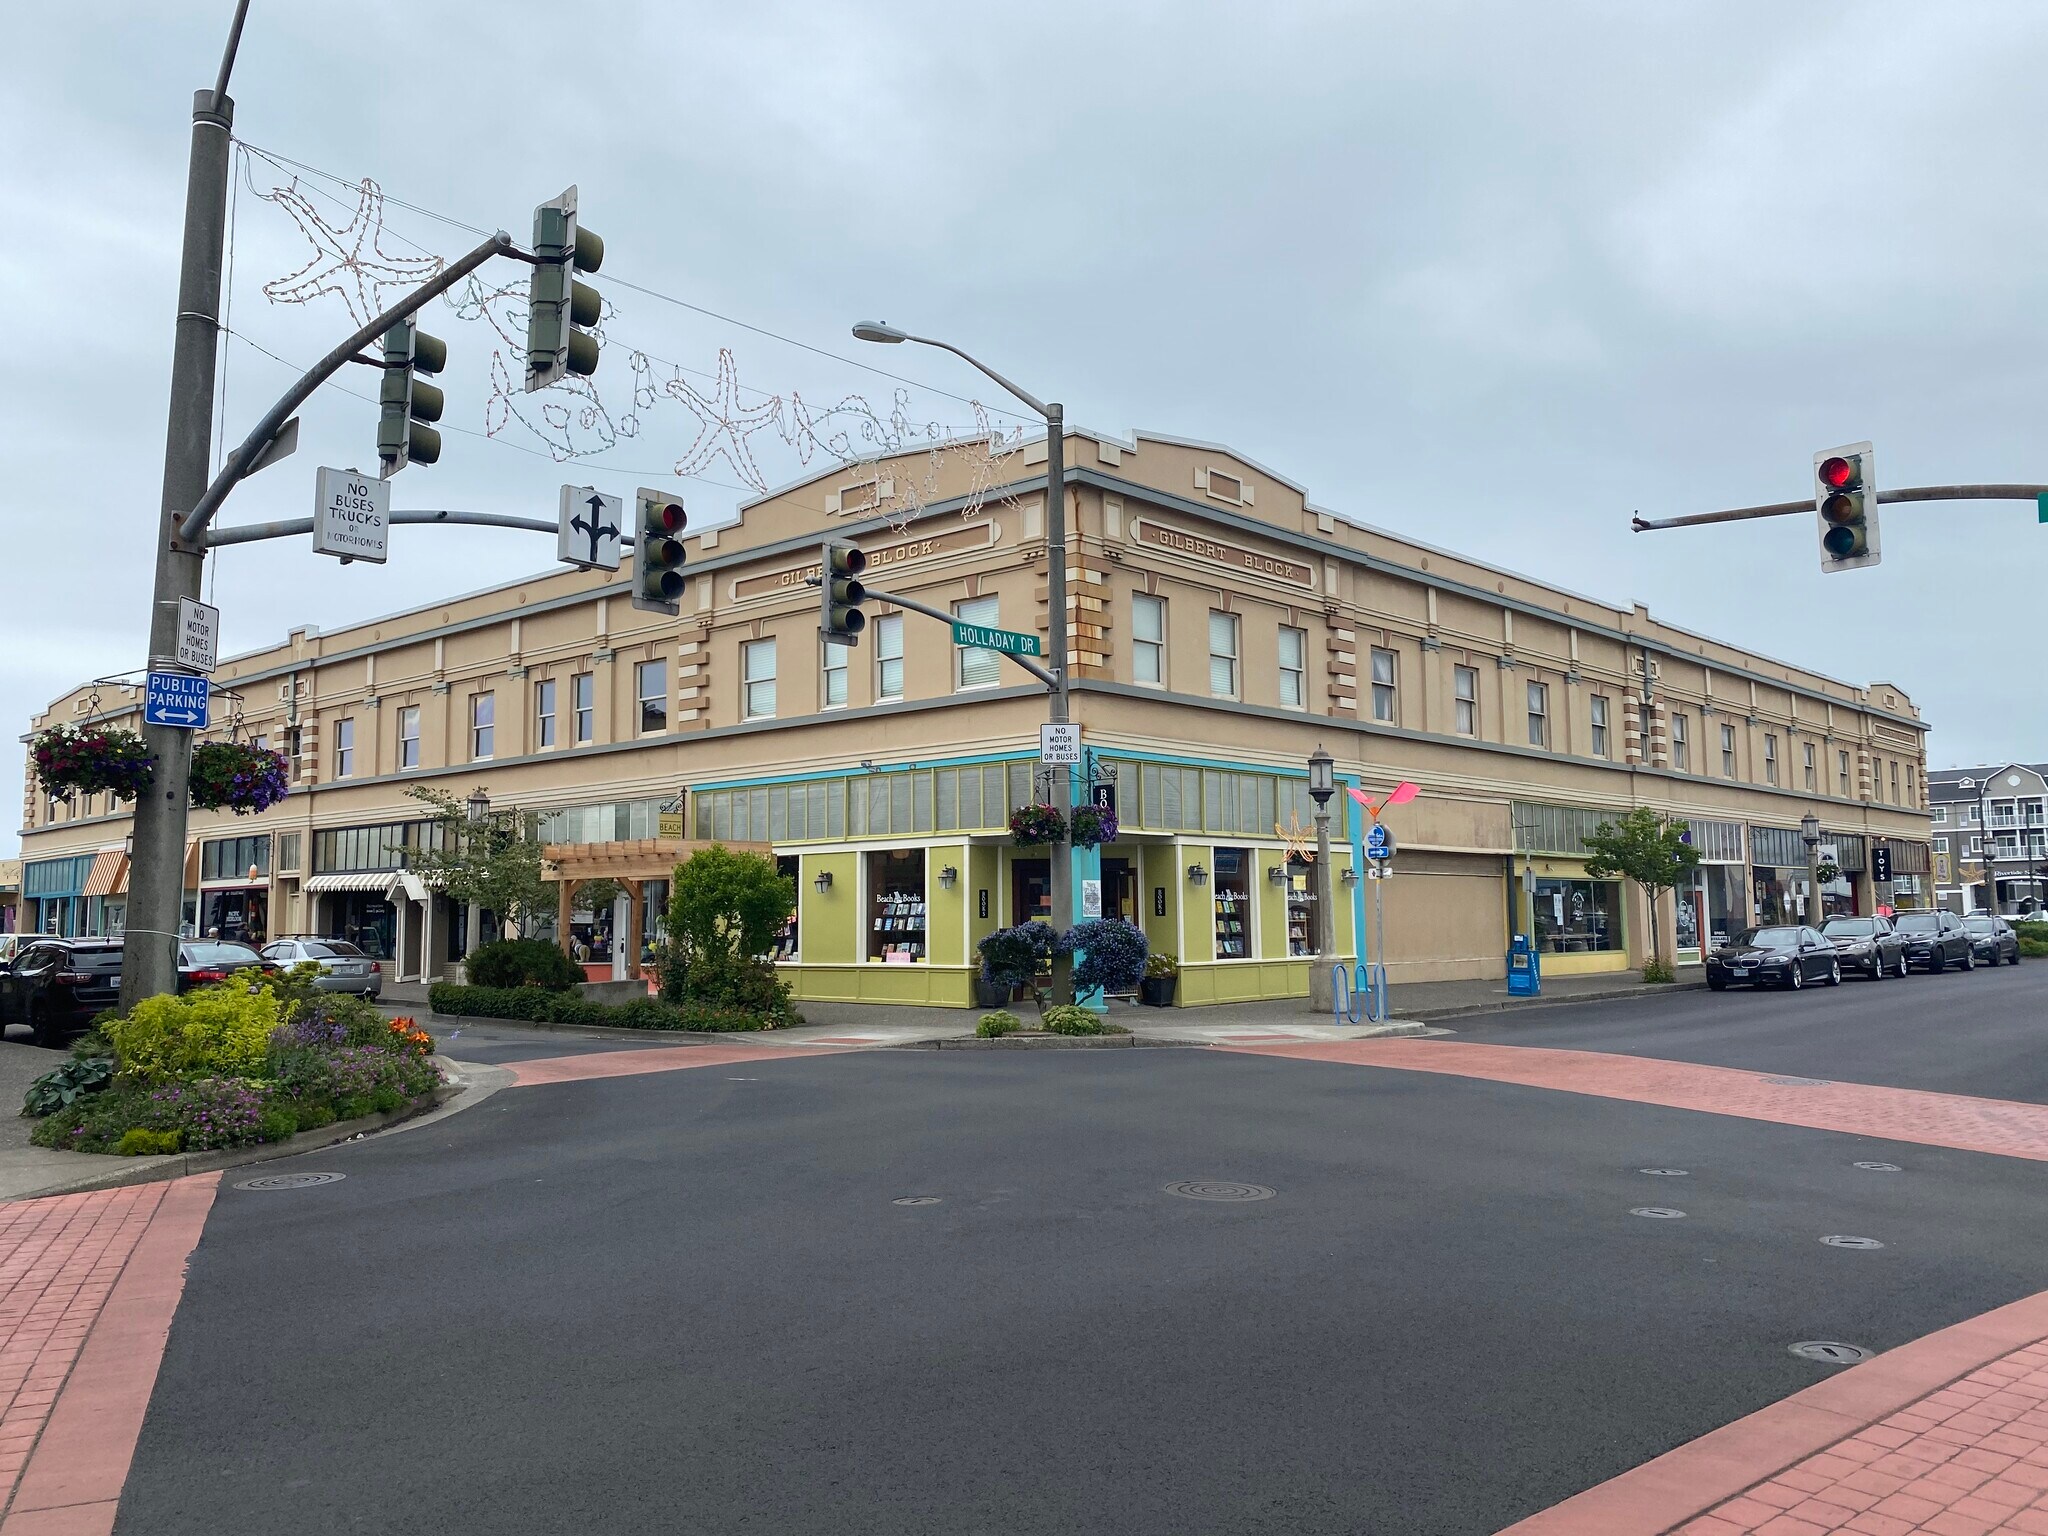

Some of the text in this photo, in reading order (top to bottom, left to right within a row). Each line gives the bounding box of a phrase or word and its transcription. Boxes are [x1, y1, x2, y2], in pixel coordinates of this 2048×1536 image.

[347, 483, 368, 497] NO
[335, 494, 374, 512] BUSES
[329, 507, 381, 527] TRUCKS
[1159, 530, 1294, 578] GILBERT BLOCK
[781, 540, 933, 586] GILBE BLOCK
[193, 607, 205, 620] NO
[186, 620, 209, 637] MOTOR
[186, 634, 209, 651] HOMES
[959, 626, 1035, 653] HOLLADAY DR
[180, 647, 213, 667] OR BUSES
[151, 676, 205, 694] PUBLIC
[148, 691, 206, 709] PARKING
[1044, 753, 1078, 761] OR BUSES
[660, 823, 681, 831] BEACH
[876, 893, 921, 903] Beach Books
[1214, 891, 1249, 900] each Books
[1287, 892, 1298, 900] each
